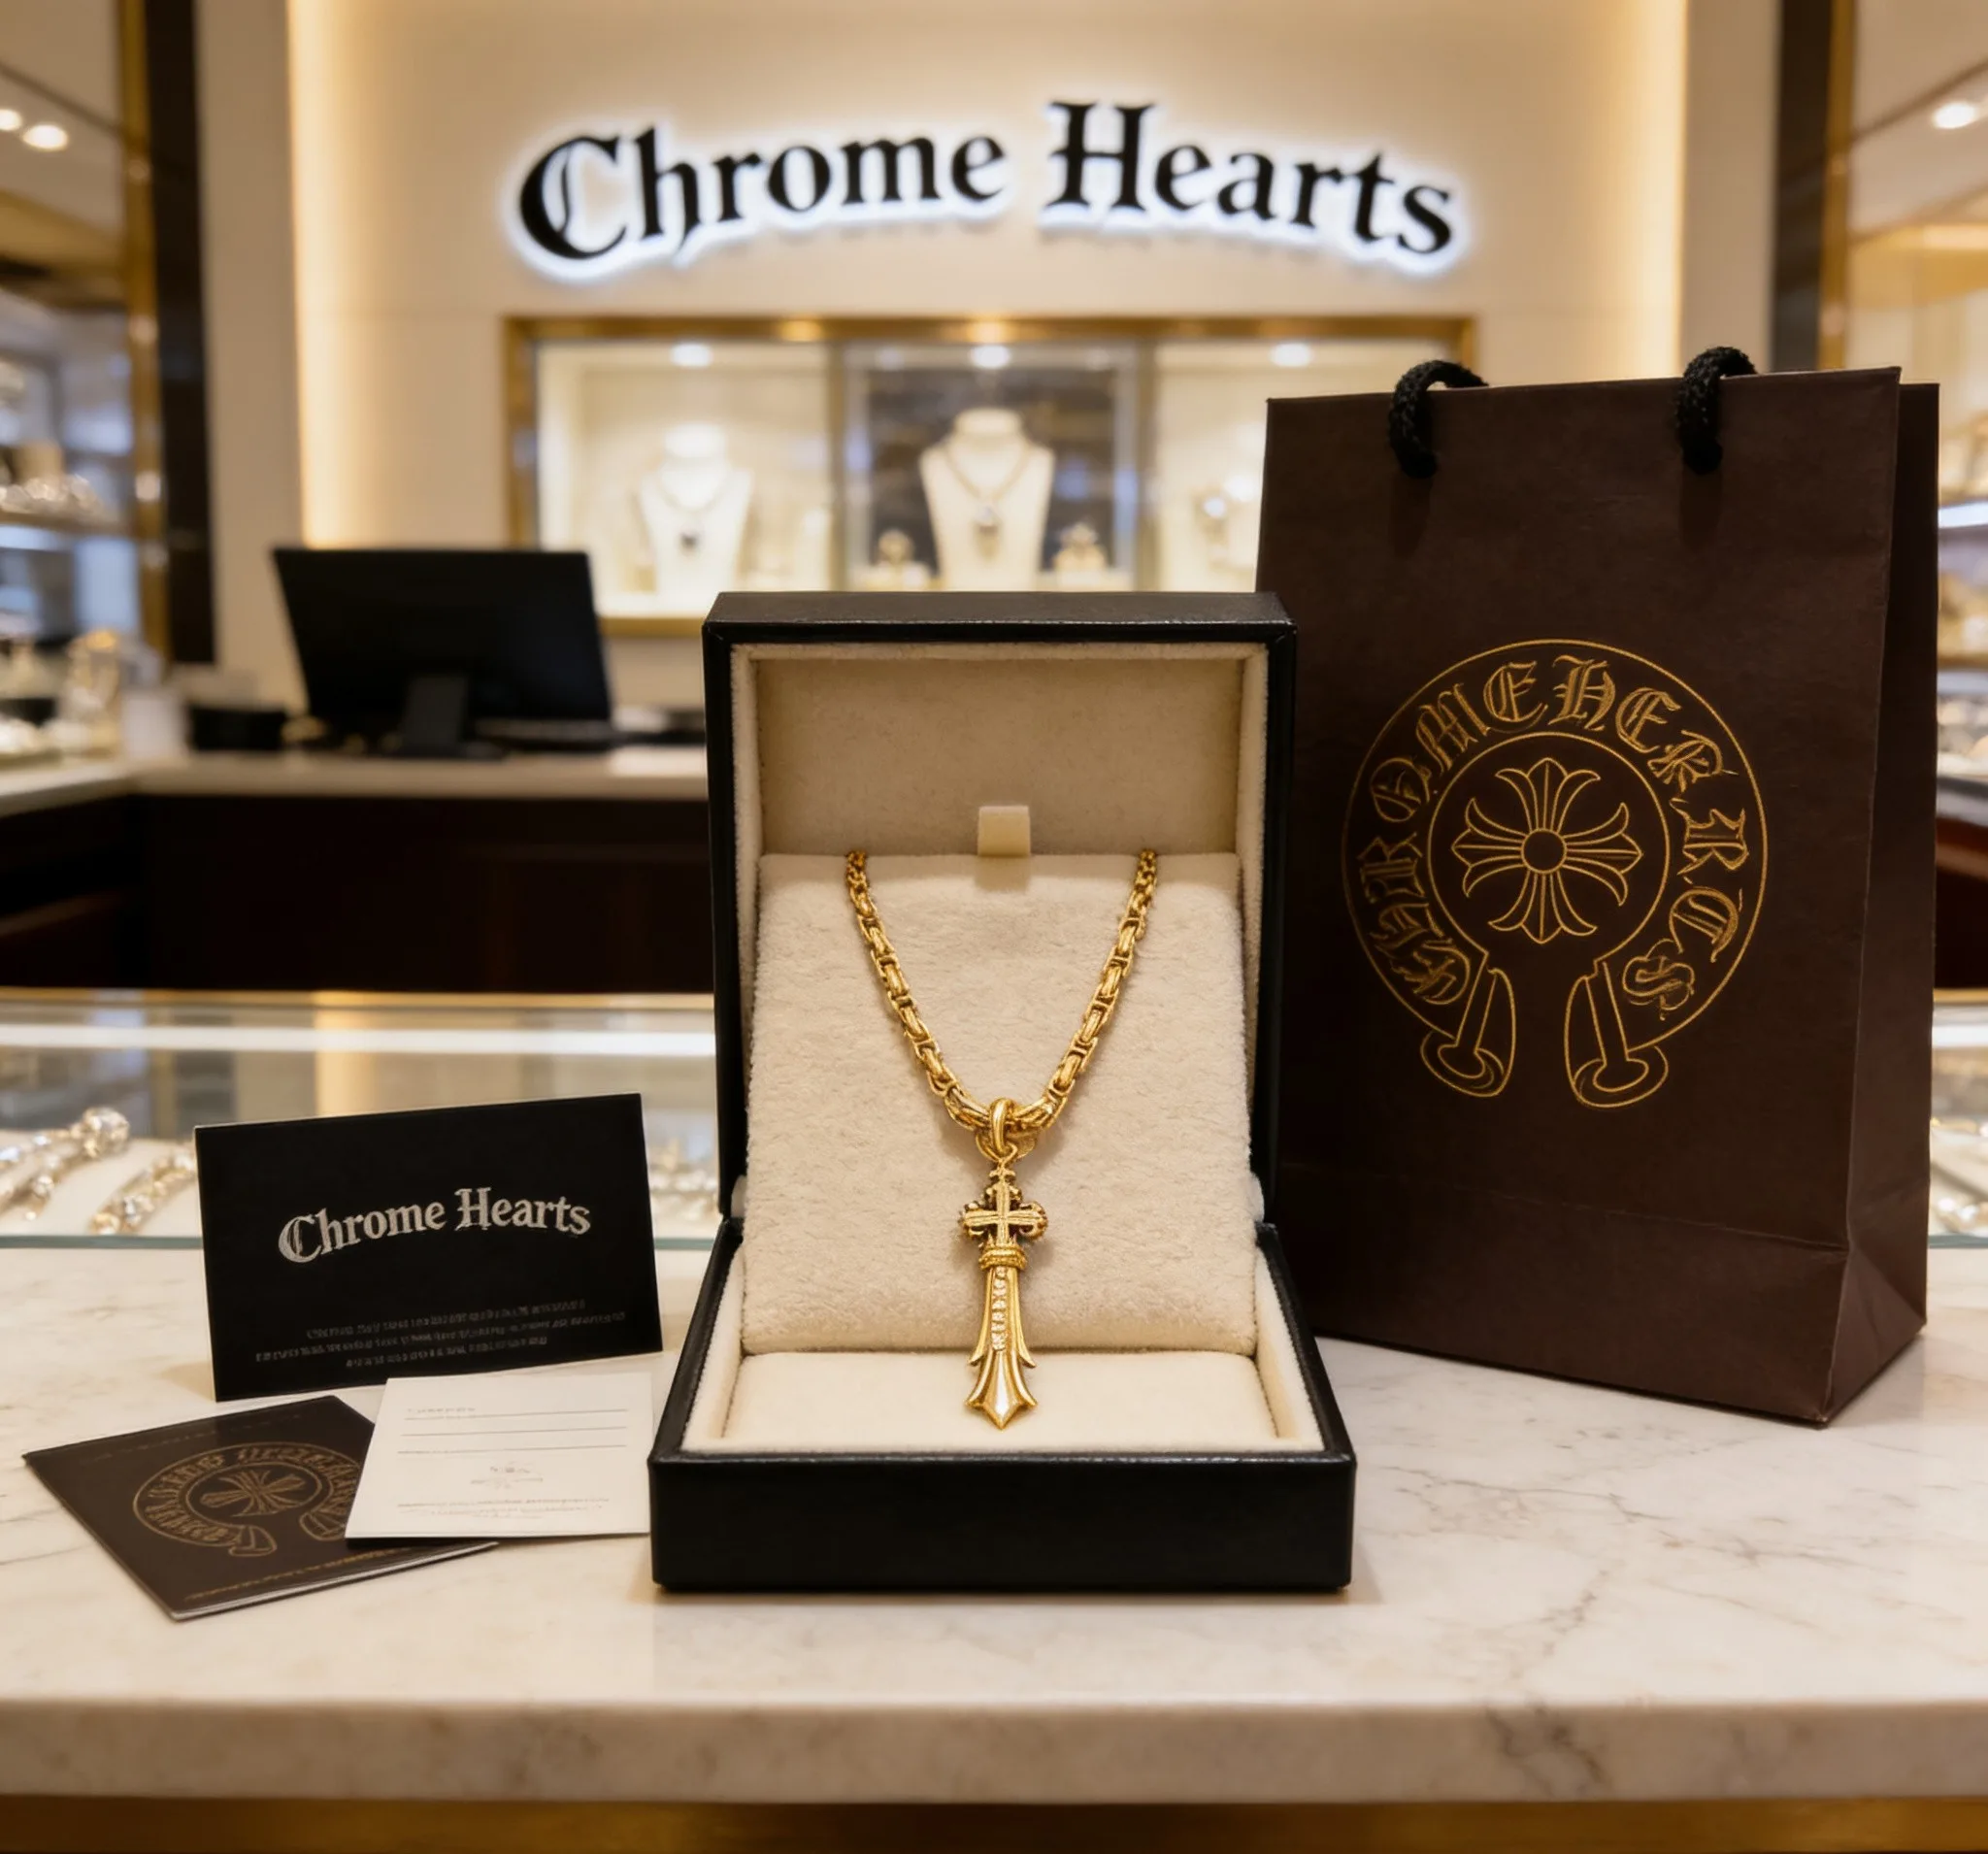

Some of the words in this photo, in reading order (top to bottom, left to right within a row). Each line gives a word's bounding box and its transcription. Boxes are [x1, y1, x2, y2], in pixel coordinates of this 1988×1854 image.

[517, 126, 1005, 262] Chrome
[1048, 102, 1454, 254] Hearts
[278, 1200, 447, 1264] Chrome
[453, 1186, 592, 1237] Hearts
